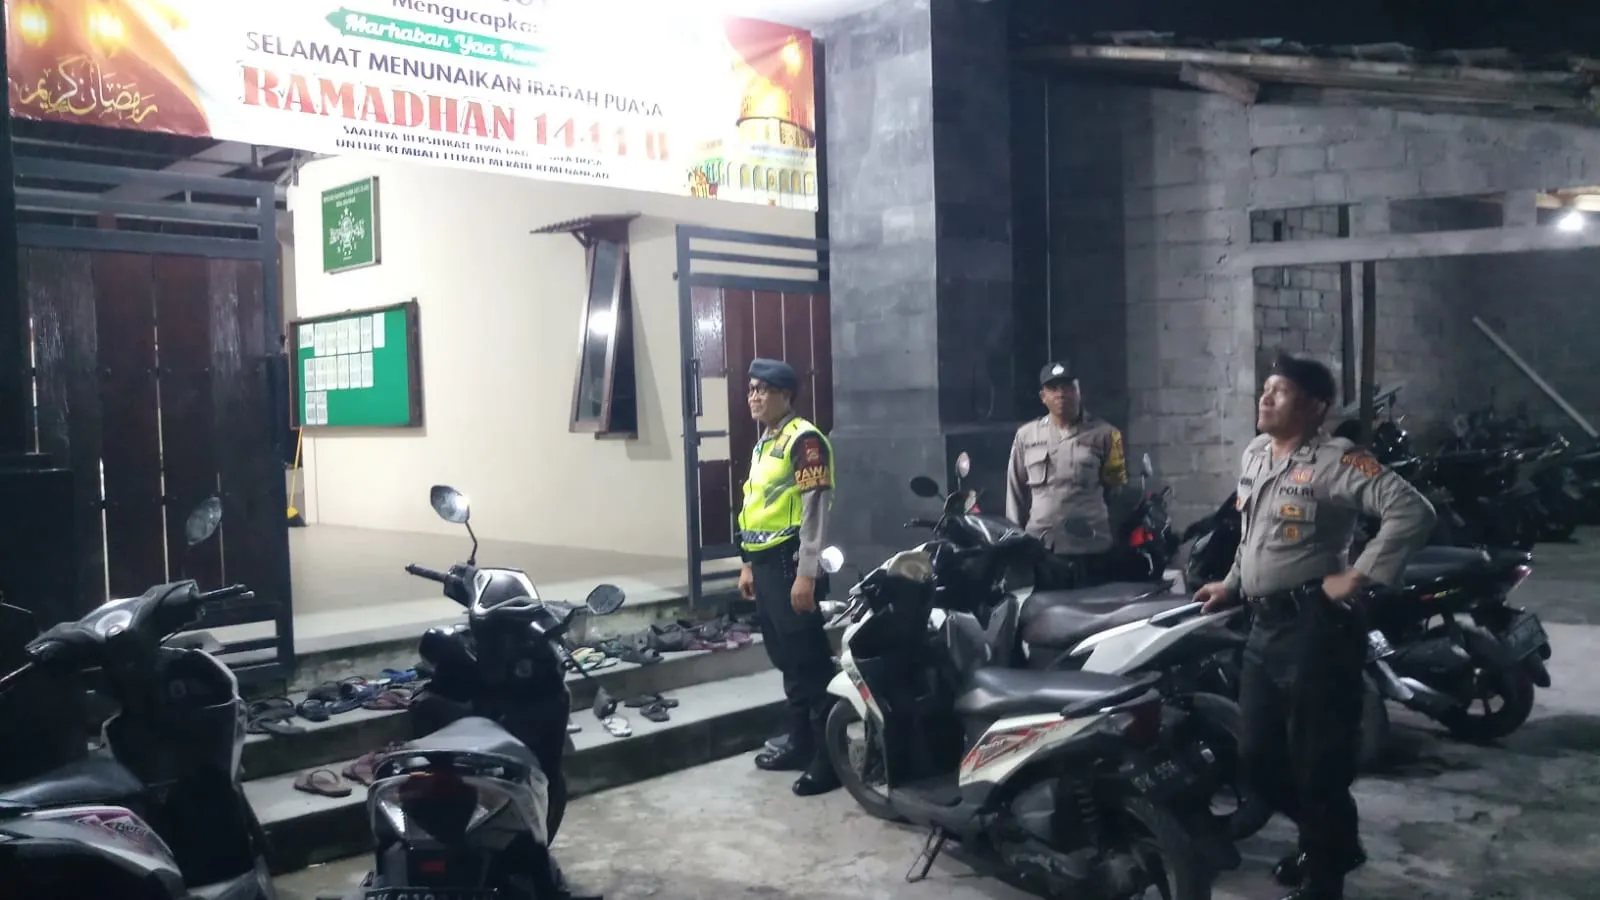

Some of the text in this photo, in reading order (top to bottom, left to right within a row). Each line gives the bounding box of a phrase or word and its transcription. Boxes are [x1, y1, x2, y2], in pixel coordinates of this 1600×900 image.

[344, 13, 451, 49] Marhaban
[454, 34, 498, 56] Yaa
[392, 0, 539, 33] Mengucapka
[245, 31, 362, 68] SELAMAT
[368, 55, 521, 94] MENUNAIKAN
[604, 94, 664, 117] PUASA
[237, 61, 516, 142] RAMADHAN
[1278, 486, 1314, 498] POLRI
